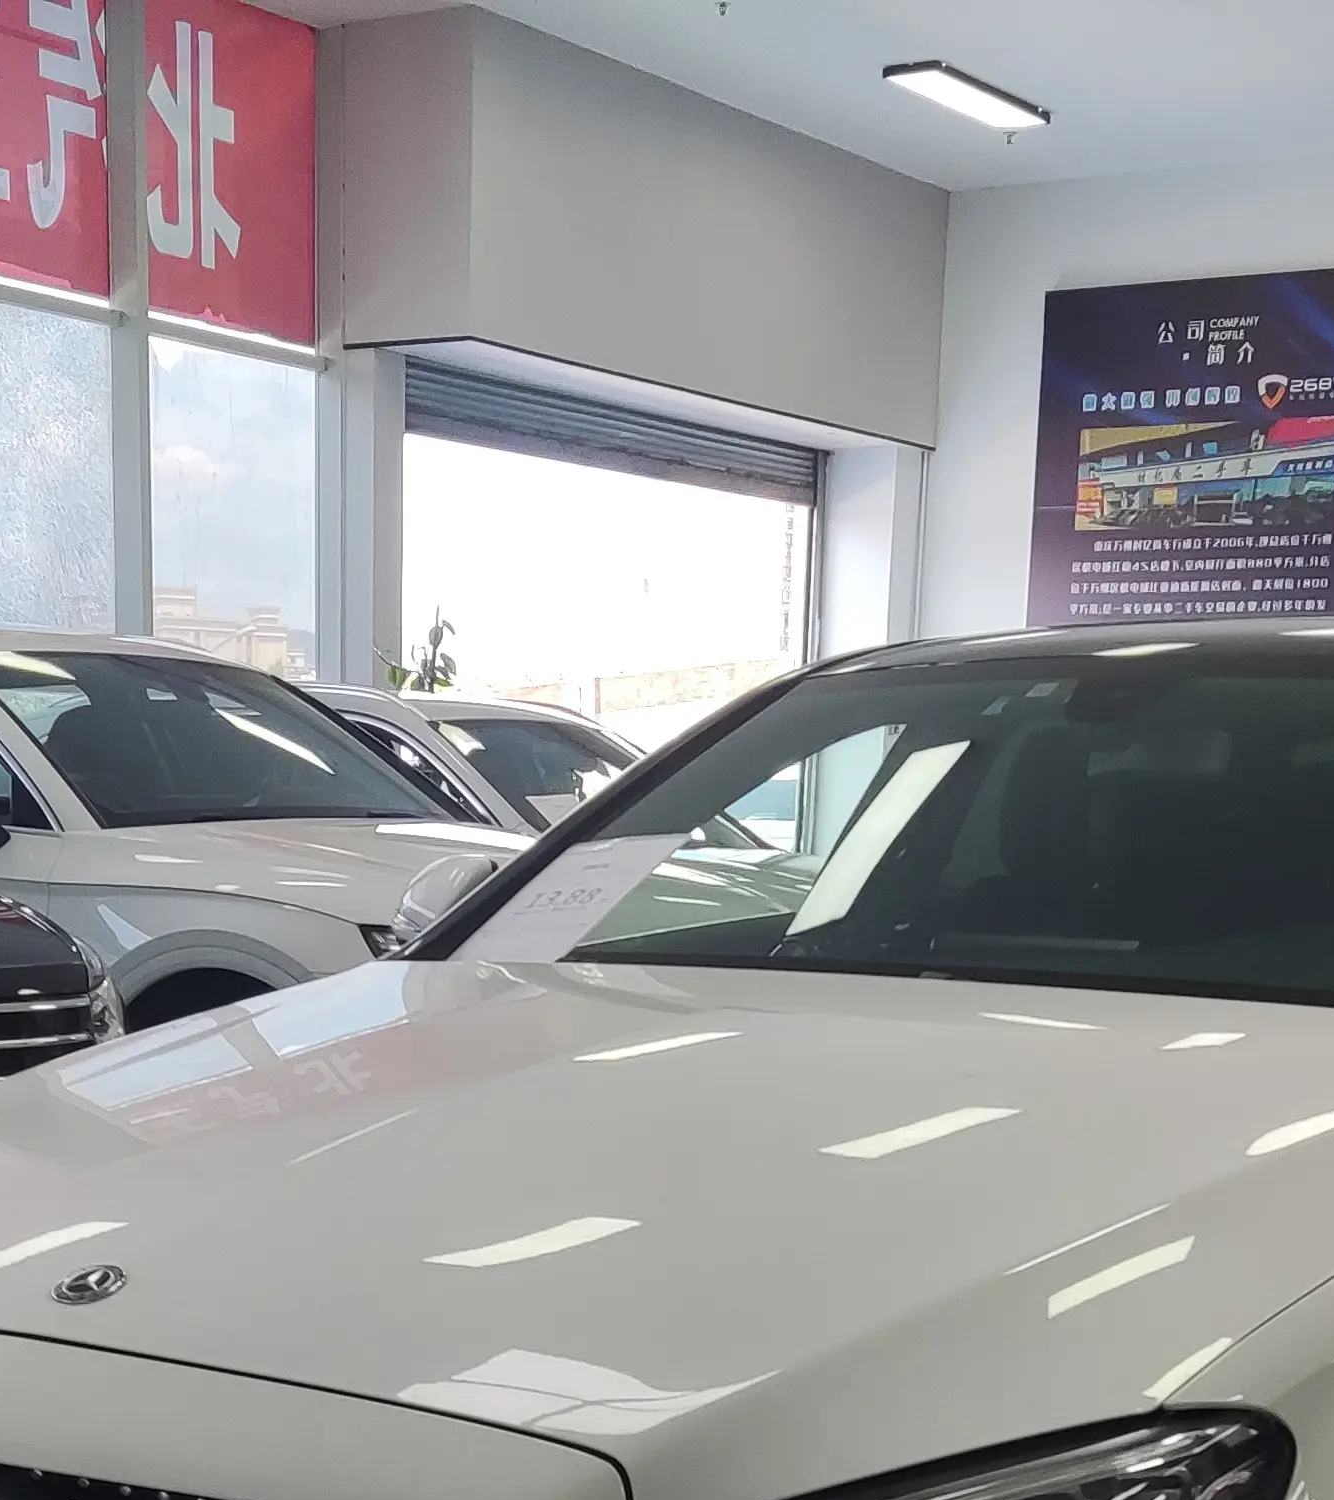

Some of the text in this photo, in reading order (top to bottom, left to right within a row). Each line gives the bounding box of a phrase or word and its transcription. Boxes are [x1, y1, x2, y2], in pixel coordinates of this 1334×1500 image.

[1158, 318, 1206, 345] 公司
[1209, 315, 1260, 329] COMPANY
[1208, 328, 1245, 342] PROFILE
[1207, 341, 1256, 366] 简介
